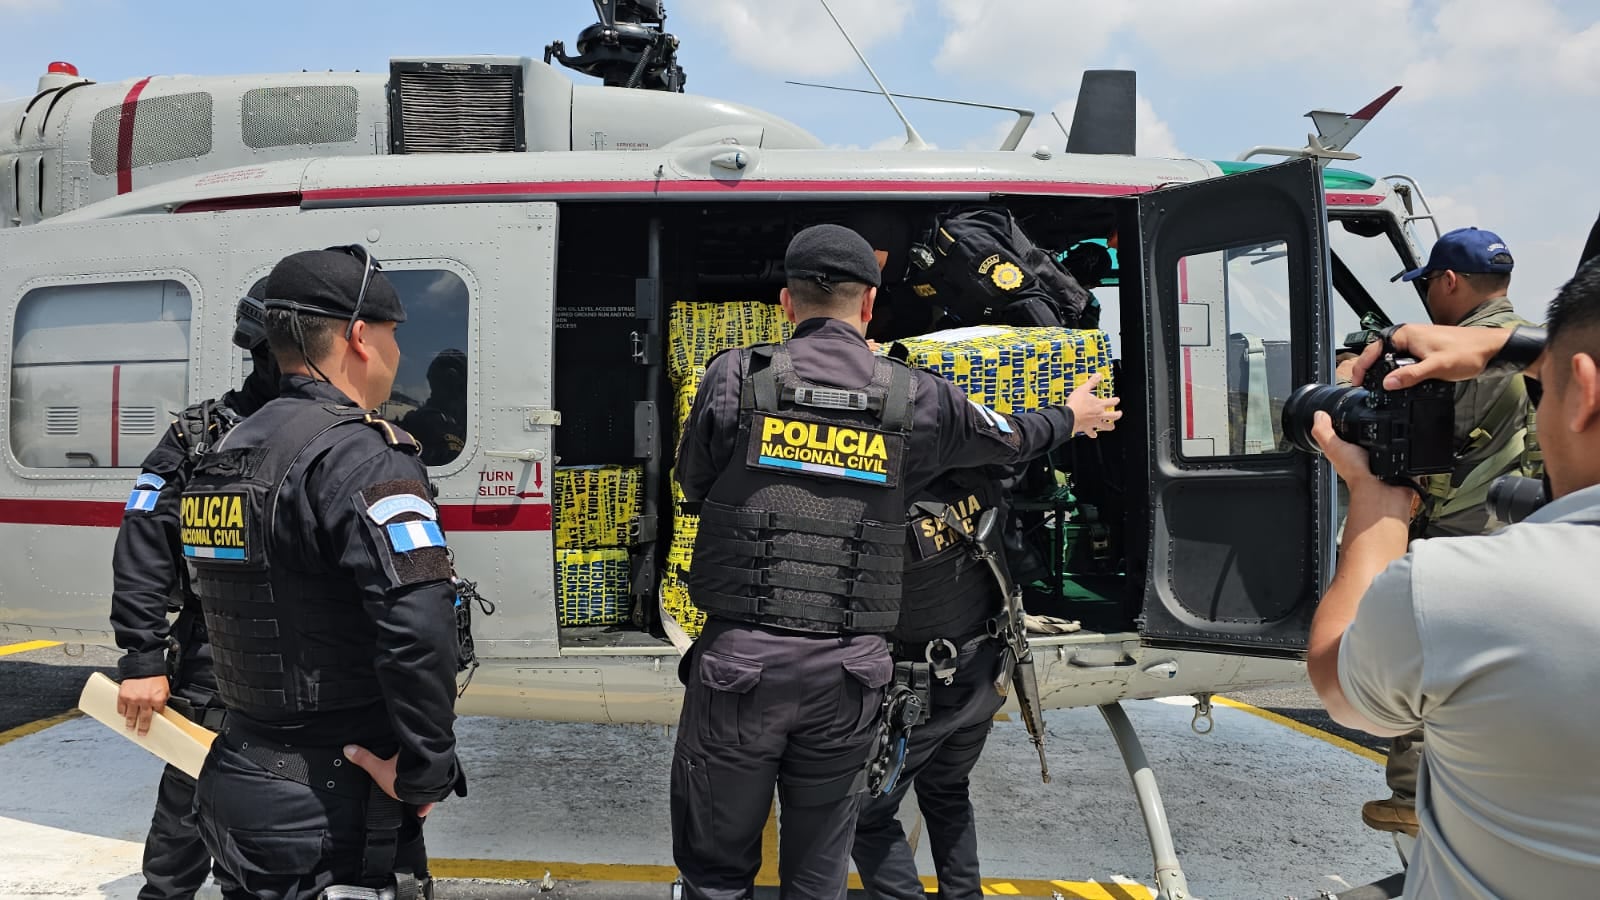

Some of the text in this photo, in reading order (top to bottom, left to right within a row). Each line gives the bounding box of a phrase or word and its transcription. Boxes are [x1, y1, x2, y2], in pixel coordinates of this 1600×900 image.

[762, 416, 888, 460] POLICIA
[761, 442, 887, 473] NACIONAL CIVIL
[478, 471, 514, 481] TURN
[478, 485, 516, 496] SLIDE
[181, 496, 244, 528] POLICIA
[214, 529, 244, 546] CIVIL
[590, 560, 605, 624] EVIDENCIA
[605, 559, 617, 622] EVIDENCIA
